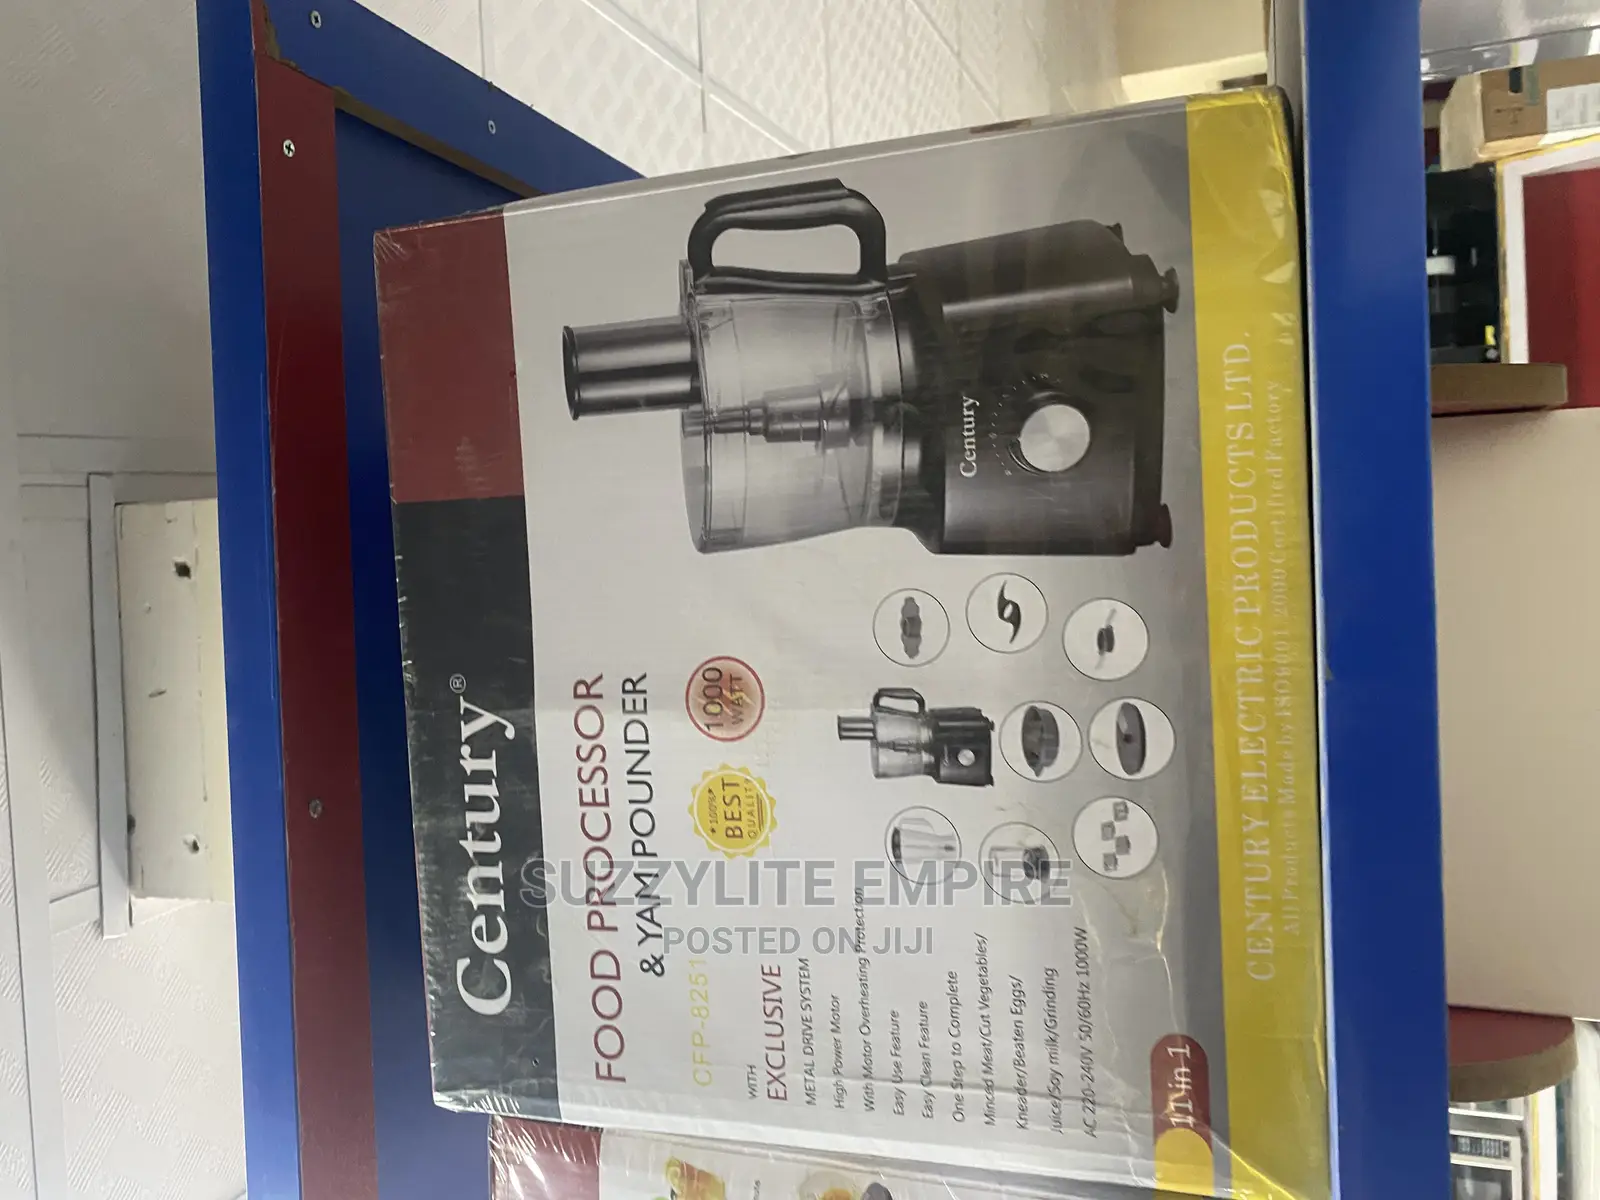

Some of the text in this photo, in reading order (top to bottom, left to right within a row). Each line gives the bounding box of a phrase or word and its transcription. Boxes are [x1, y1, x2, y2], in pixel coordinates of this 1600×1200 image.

[959, 396, 980, 478] Century
[1263, 381, 1285, 460] Factory
[702, 667, 724, 731] 1000
[730, 673, 744, 726] WATT
[1222, 332, 1276, 981] CENTURY ELECTRIC PRODUCTS LTD.
[622, 673, 664, 977] & YAM POUNDER
[721, 776, 744, 839] BEST
[573, 673, 627, 1084] FOOD PROCESSOR
[688, 957, 713, 1087] CFP-8251
[761, 964, 788, 1101] EXCLUSIVE
[798, 958, 816, 1106] METAL DRIVE SYSTEM
[829, 994, 847, 1109] High Power Motor
[852, 887, 875, 1112] With Motor Overheating Protection
[888, 1009, 906, 1116] Easy Use Feature
[917, 1000, 936, 1119] Easy Clean Feature
[946, 970, 965, 1123] One Step to Complete
[974, 932, 996, 1126] Minced Meat/Cut Vegetables/
[1008, 974, 1030, 1130] Kneader/Beaten Eggs/
[1042, 967, 1064, 1135] Juice/Soy milk/Grinding
[1074, 926, 1097, 1138] AC 220-240V 50/60Hz 1000W
[747, 1064, 758, 1100] WITH
[1166, 1044, 1194, 1128] 11 in 1
